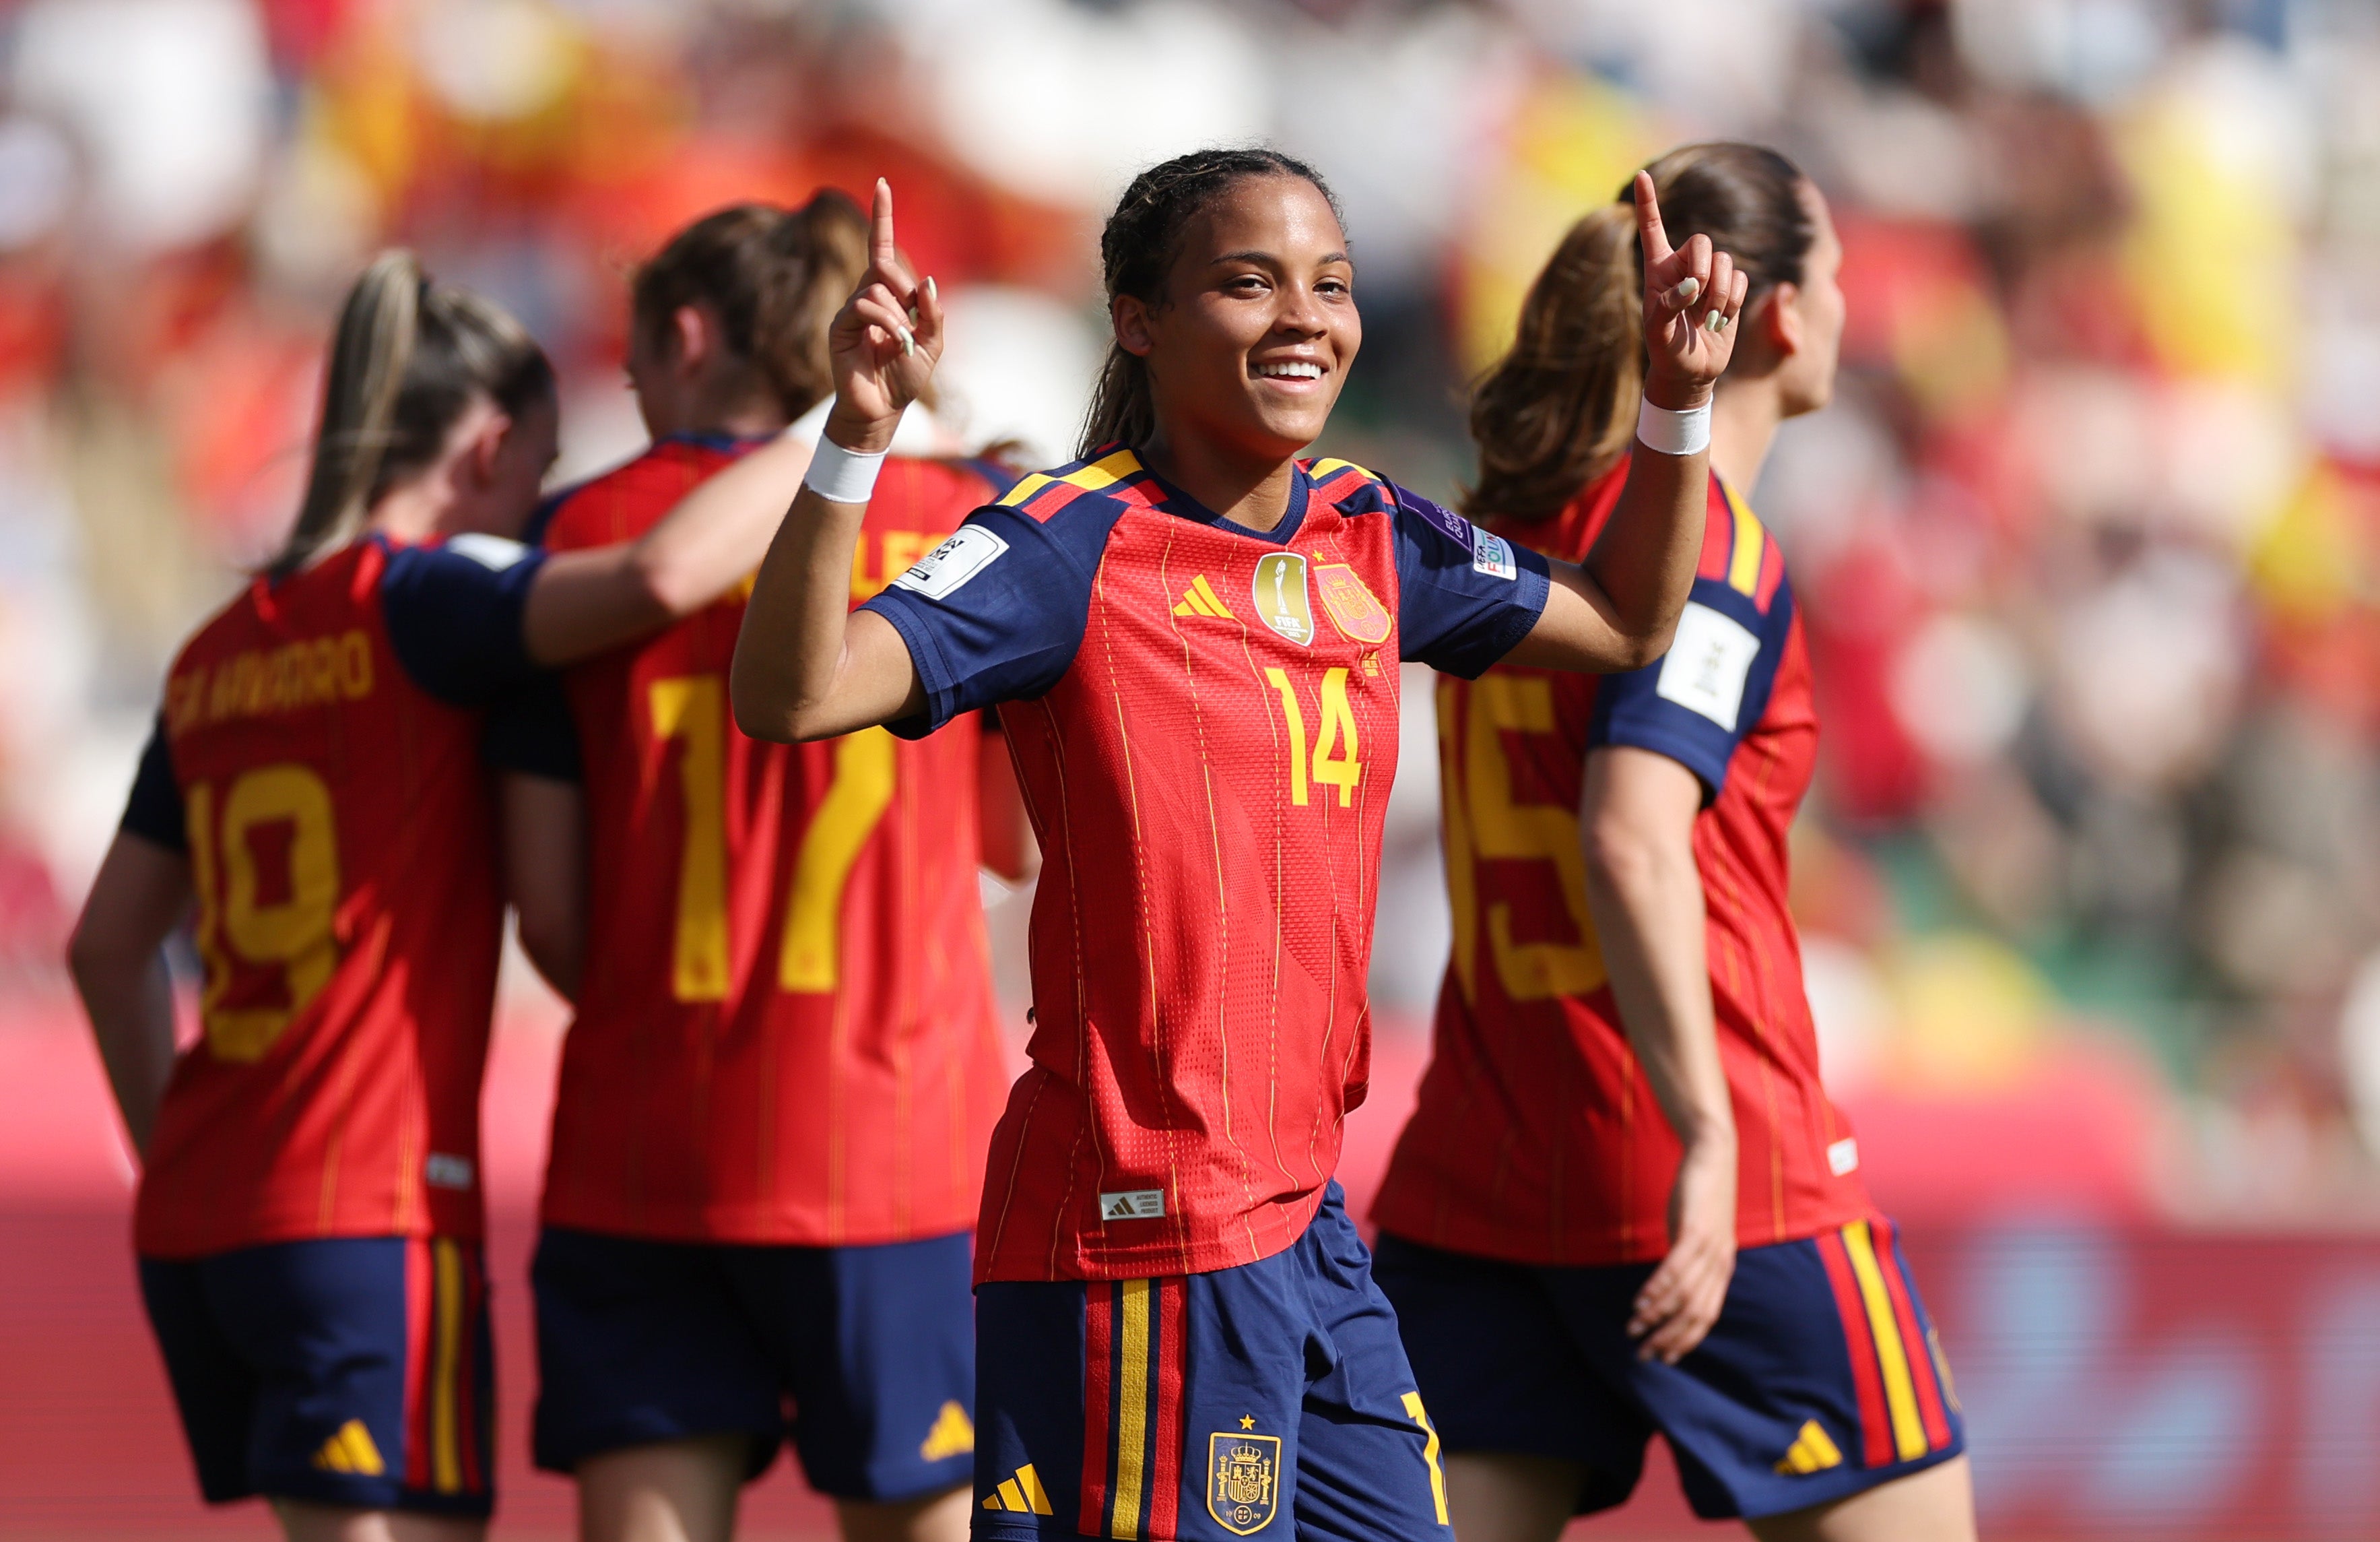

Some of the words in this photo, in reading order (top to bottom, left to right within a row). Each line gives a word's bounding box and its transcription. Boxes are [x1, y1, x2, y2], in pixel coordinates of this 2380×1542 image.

[1476, 545, 1486, 570] UEFA
[1274, 615, 1301, 629] FIFA
[1263, 666, 1362, 808] 14
[647, 676, 898, 1002] 17
